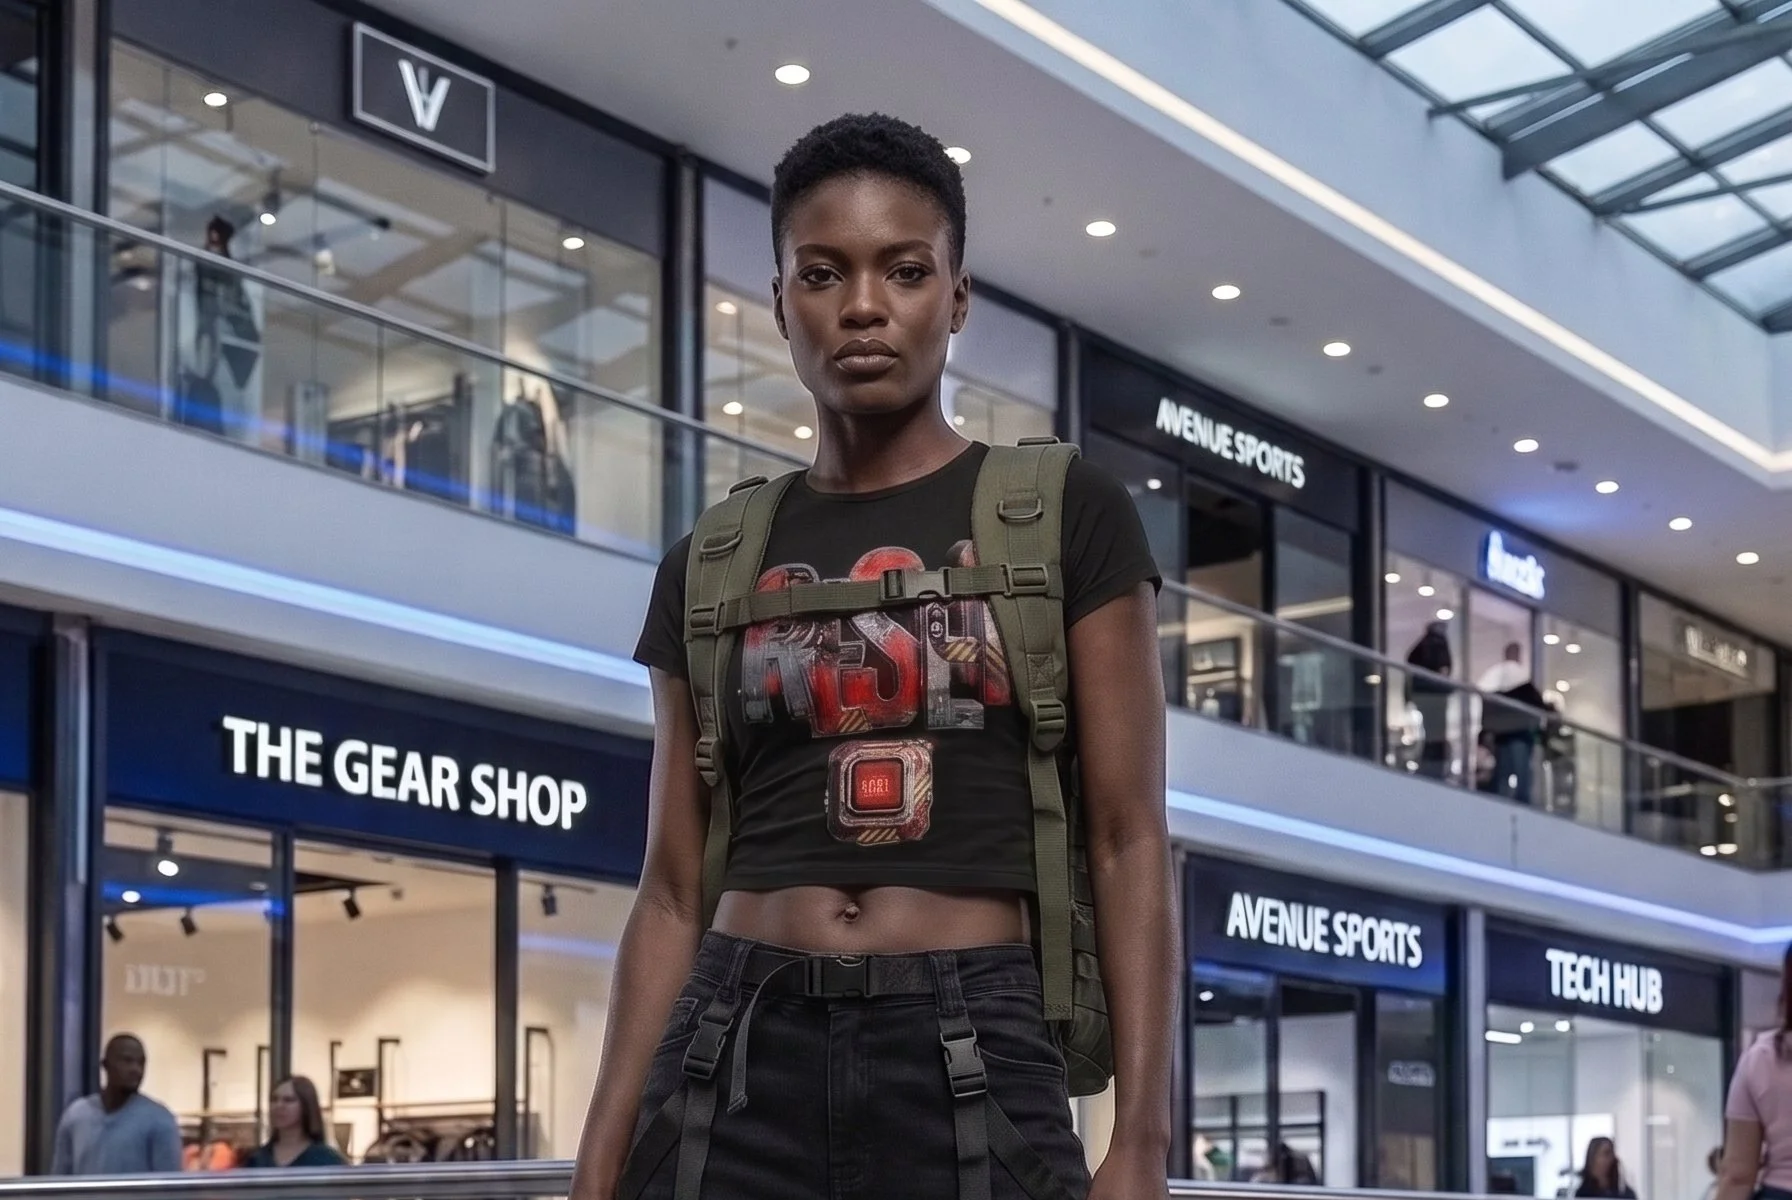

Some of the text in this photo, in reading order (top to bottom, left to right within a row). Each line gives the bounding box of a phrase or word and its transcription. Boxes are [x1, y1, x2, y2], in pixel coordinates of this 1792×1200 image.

[1155, 397, 1306, 490] AVENUE SPORTS
[222, 715, 588, 831] THE GEAR SHOP
[1226, 891, 1423, 968] AVENUE SPORTS
[1545, 948, 1664, 1014] TECH HUB
